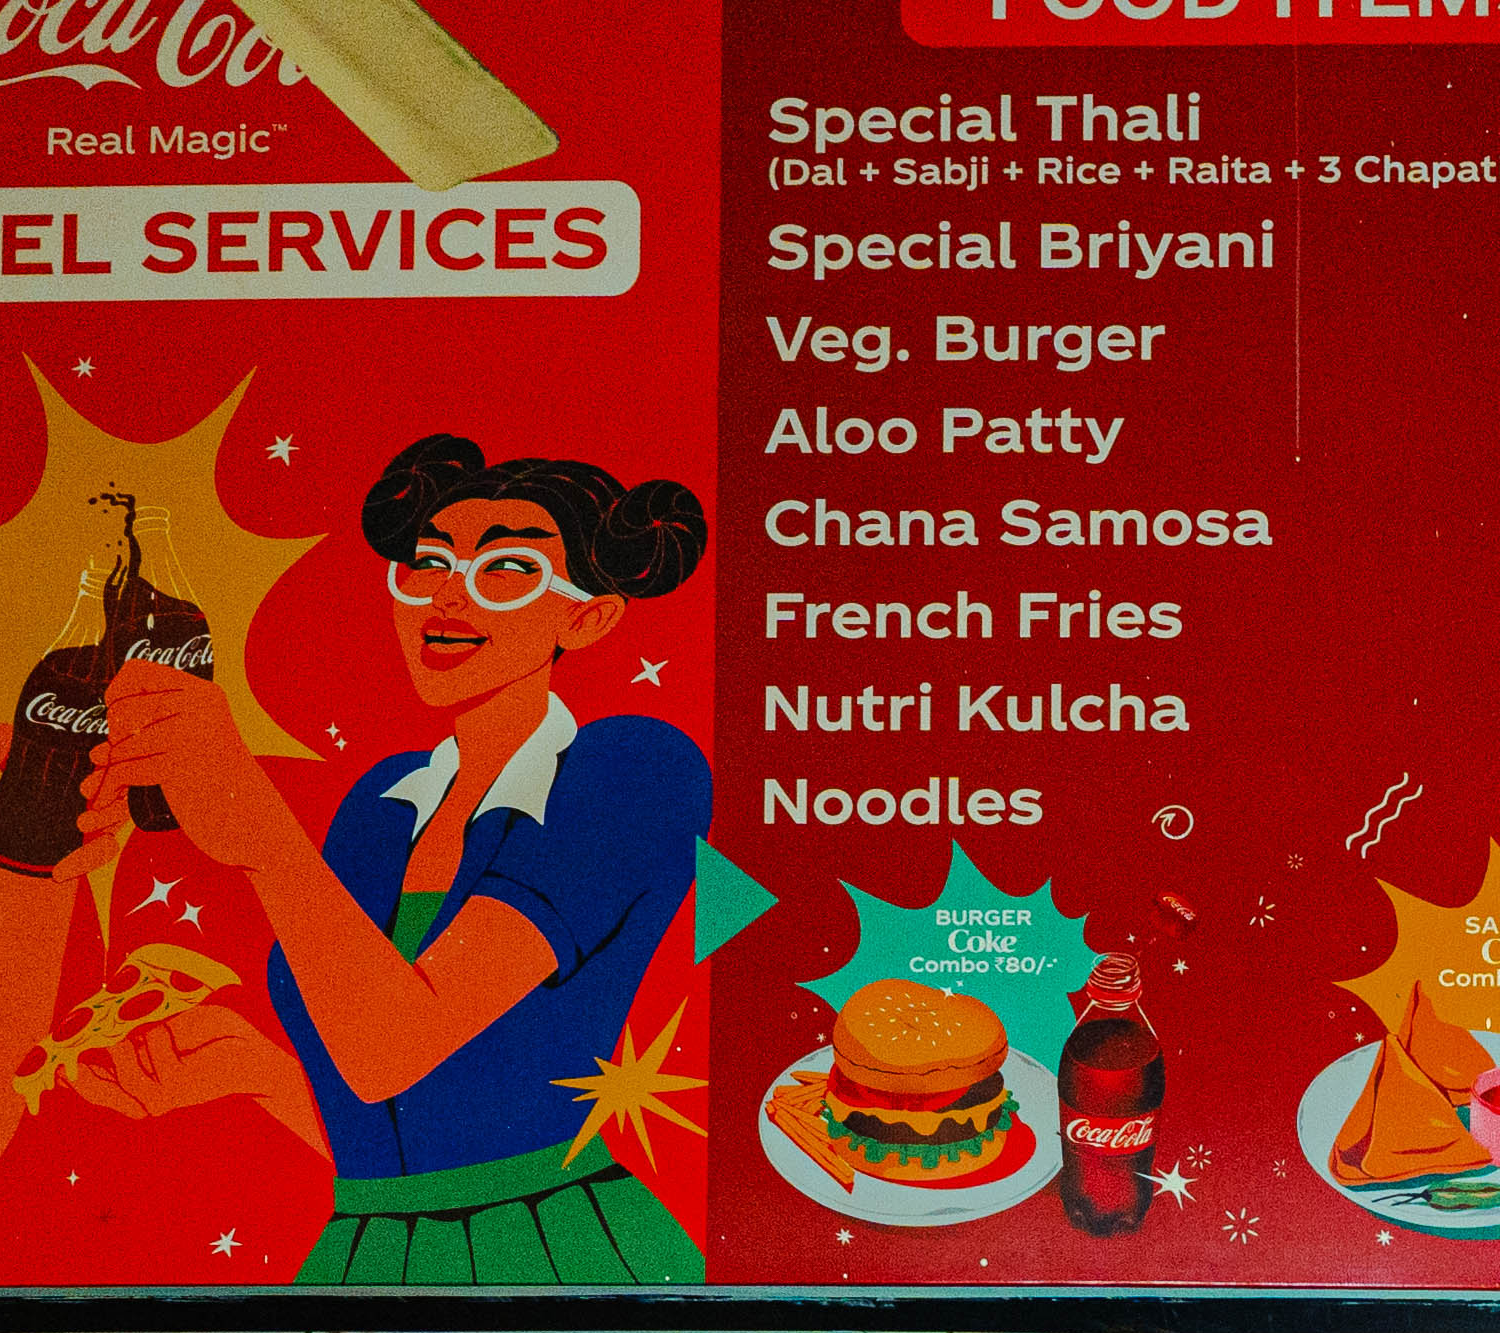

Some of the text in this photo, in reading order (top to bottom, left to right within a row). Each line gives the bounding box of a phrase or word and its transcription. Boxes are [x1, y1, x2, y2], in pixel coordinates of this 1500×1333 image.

[48, 126, 135, 155] Real
[769, 94, 1017, 153] Special
[1037, 92, 1200, 141] Thali
[769, 158, 847, 190] (Dal
[894, 156, 988, 191] Sabji
[1038, 156, 1121, 184] Rice
[1169, 155, 1271, 184] Raita
[1319, 156, 1341, 183] 3
[142, 207, 606, 275] SERVICES
[768, 221, 1016, 281] Special
[1041, 219, 1273, 279] Briyani
[766, 317, 909, 373] Veg.
[936, 316, 1165, 372] Burger
[765, 407, 917, 454] Aloo
[943, 408, 1124, 464] Patty
[765, 499, 979, 546] Chana
[1001, 500, 1272, 546] Samosa
[766, 591, 992, 639] French
[1020, 590, 1182, 638] Fries
[765, 681, 931, 731] Nutri
[959, 684, 1189, 731] Kulcha
[764, 778, 1042, 825] Noodles
[936, 909, 1031, 926] BURGER
[909, 956, 989, 973] Combo
[948, 930, 1017, 953] Coke
[1066, 1116, 1153, 1149] Coca-Cola
